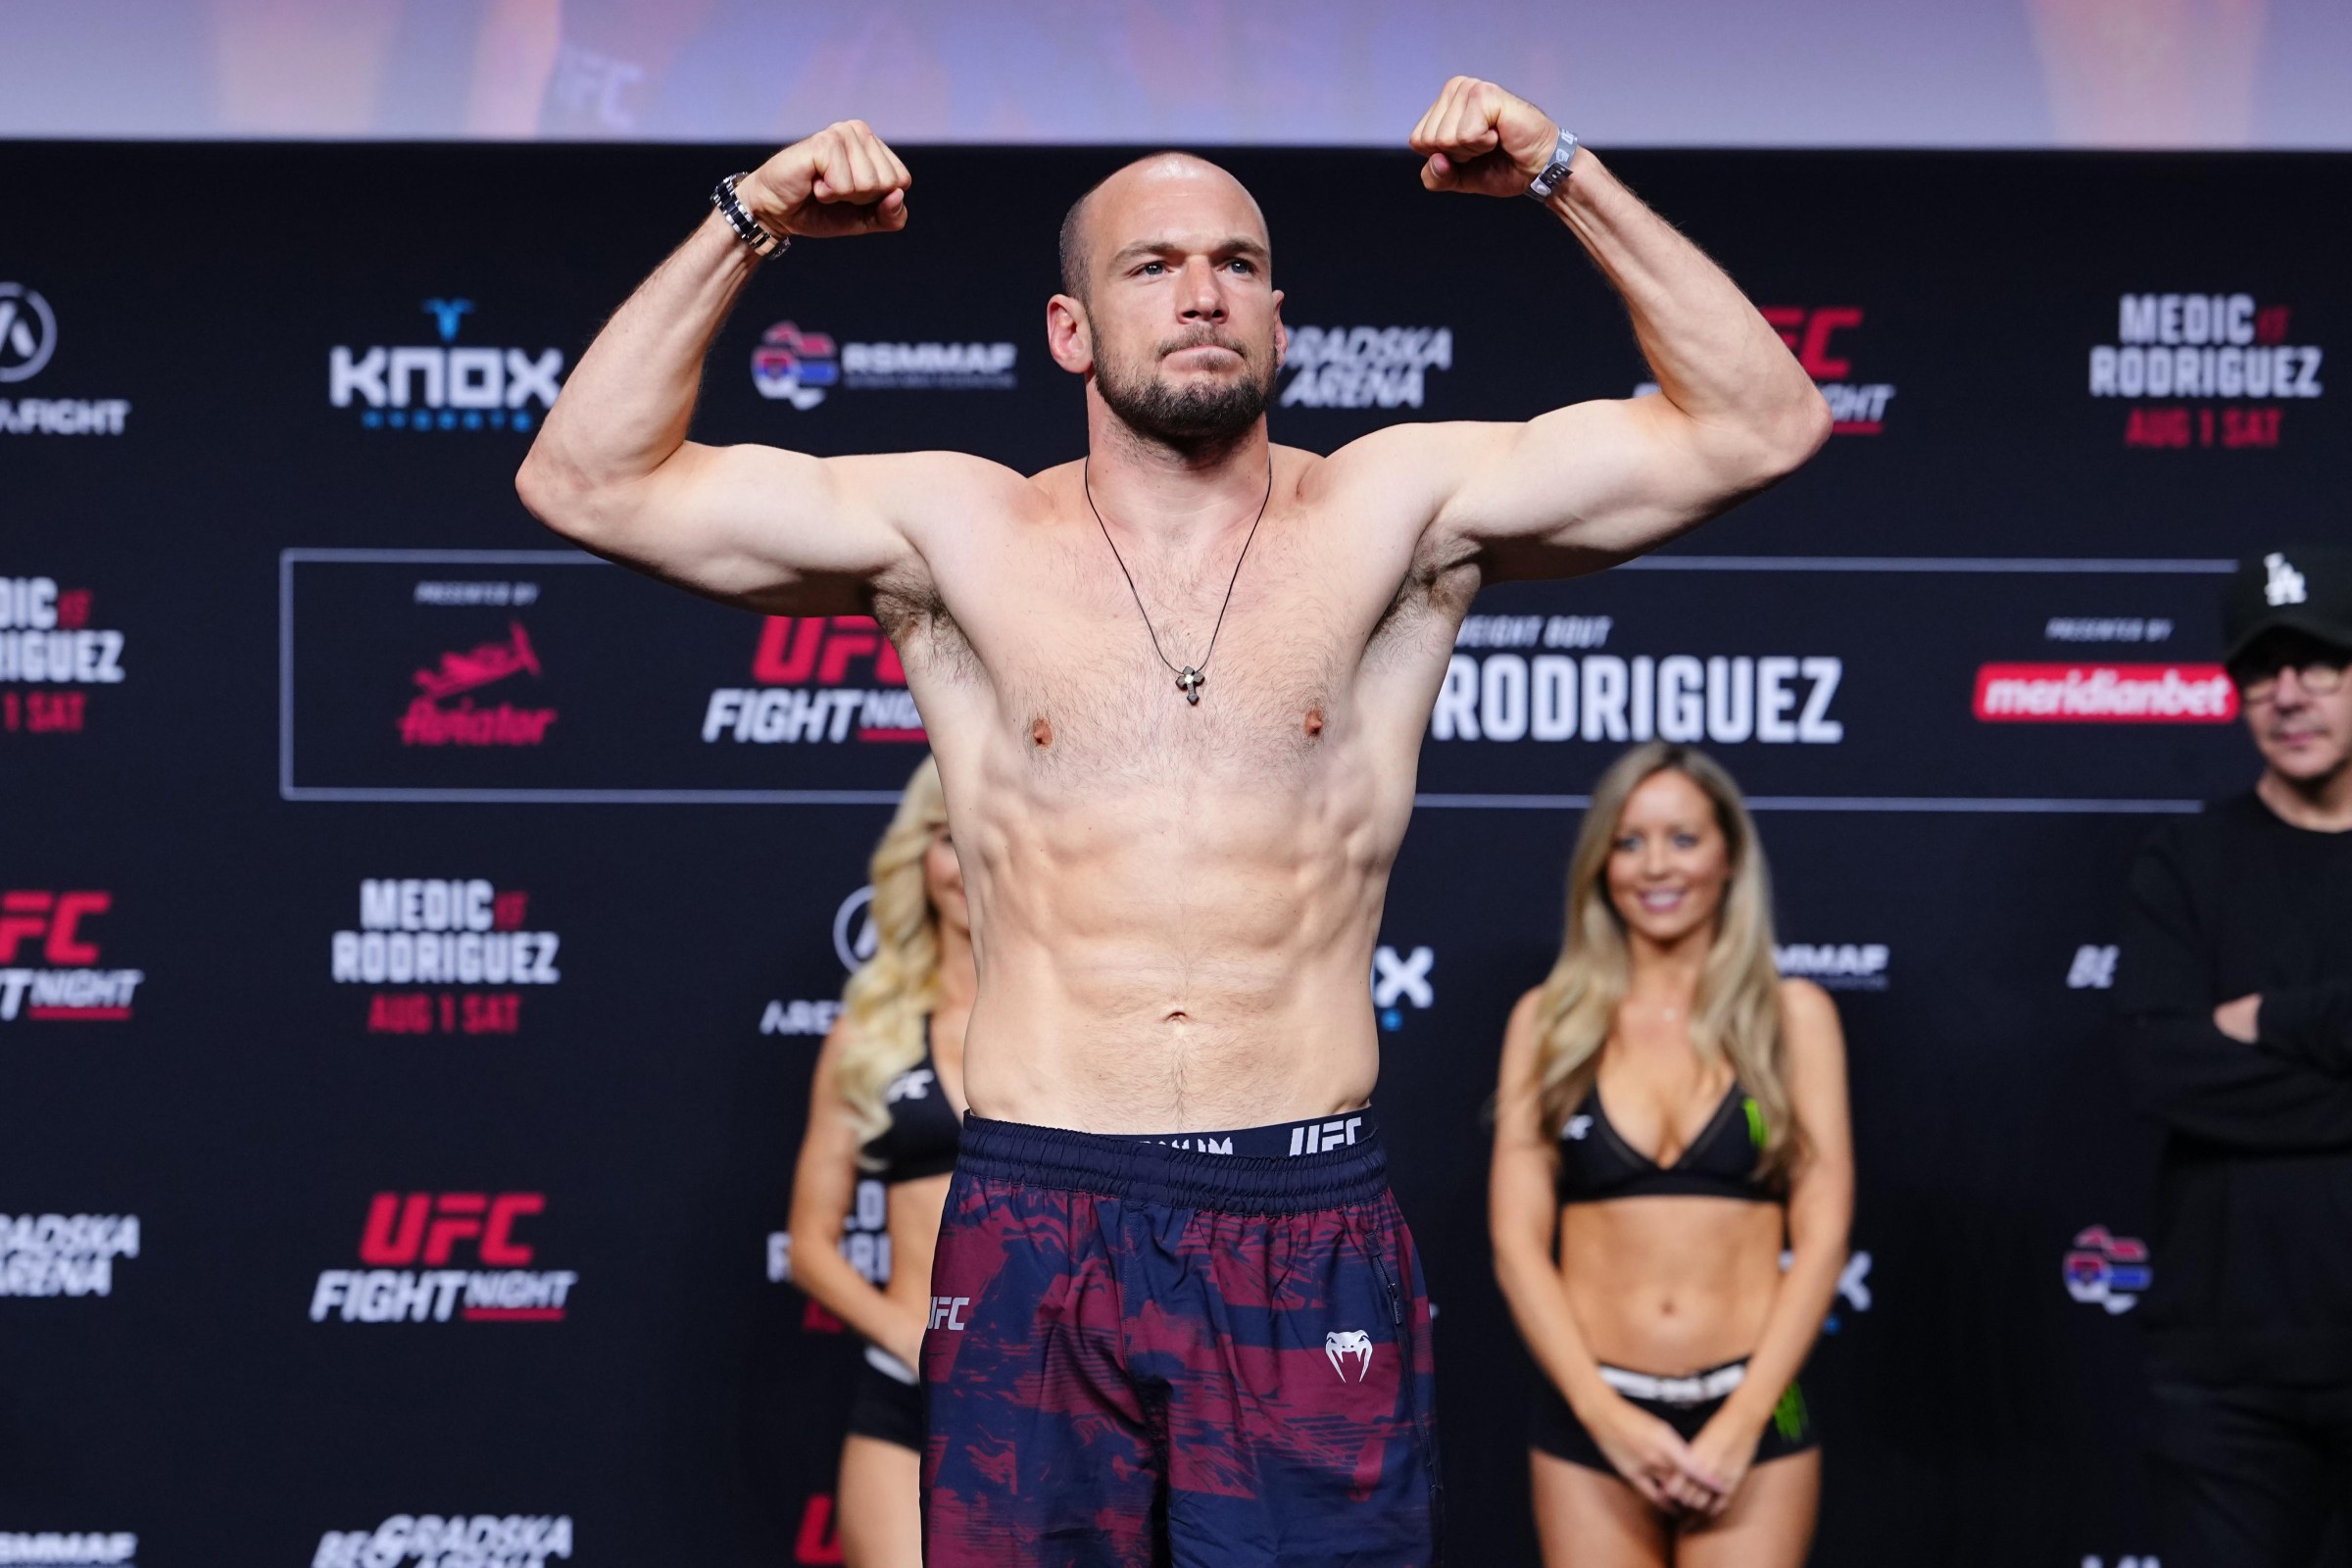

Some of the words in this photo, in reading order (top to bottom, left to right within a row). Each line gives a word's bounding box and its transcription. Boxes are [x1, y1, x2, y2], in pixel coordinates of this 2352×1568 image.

[2120, 293, 2255, 345] MEDIC
[841, 342, 1017, 375] RSMMAF
[2089, 345, 2324, 398] RODRIGUEZ
[2126, 408, 2190, 447] AUG
[2222, 408, 2281, 447] SAT
[752, 615, 908, 685] UF
[26, 691, 87, 733] SAT
[701, 688, 863, 744] FIGHT
[1432, 654, 1843, 743] RODRIGUEZ
[1984, 668, 2231, 716] meridianbet
[360, 878, 494, 932] MEDIC
[331, 931, 562, 984] RODRIGUEZ
[29, 968, 145, 1007] NIGHT
[368, 993, 432, 1035] AUG
[462, 993, 523, 1035] SAT
[359, 1192, 545, 1265] UFC
[309, 1269, 467, 1323] FIGHT
[463, 1270, 578, 1308] NIGHT
